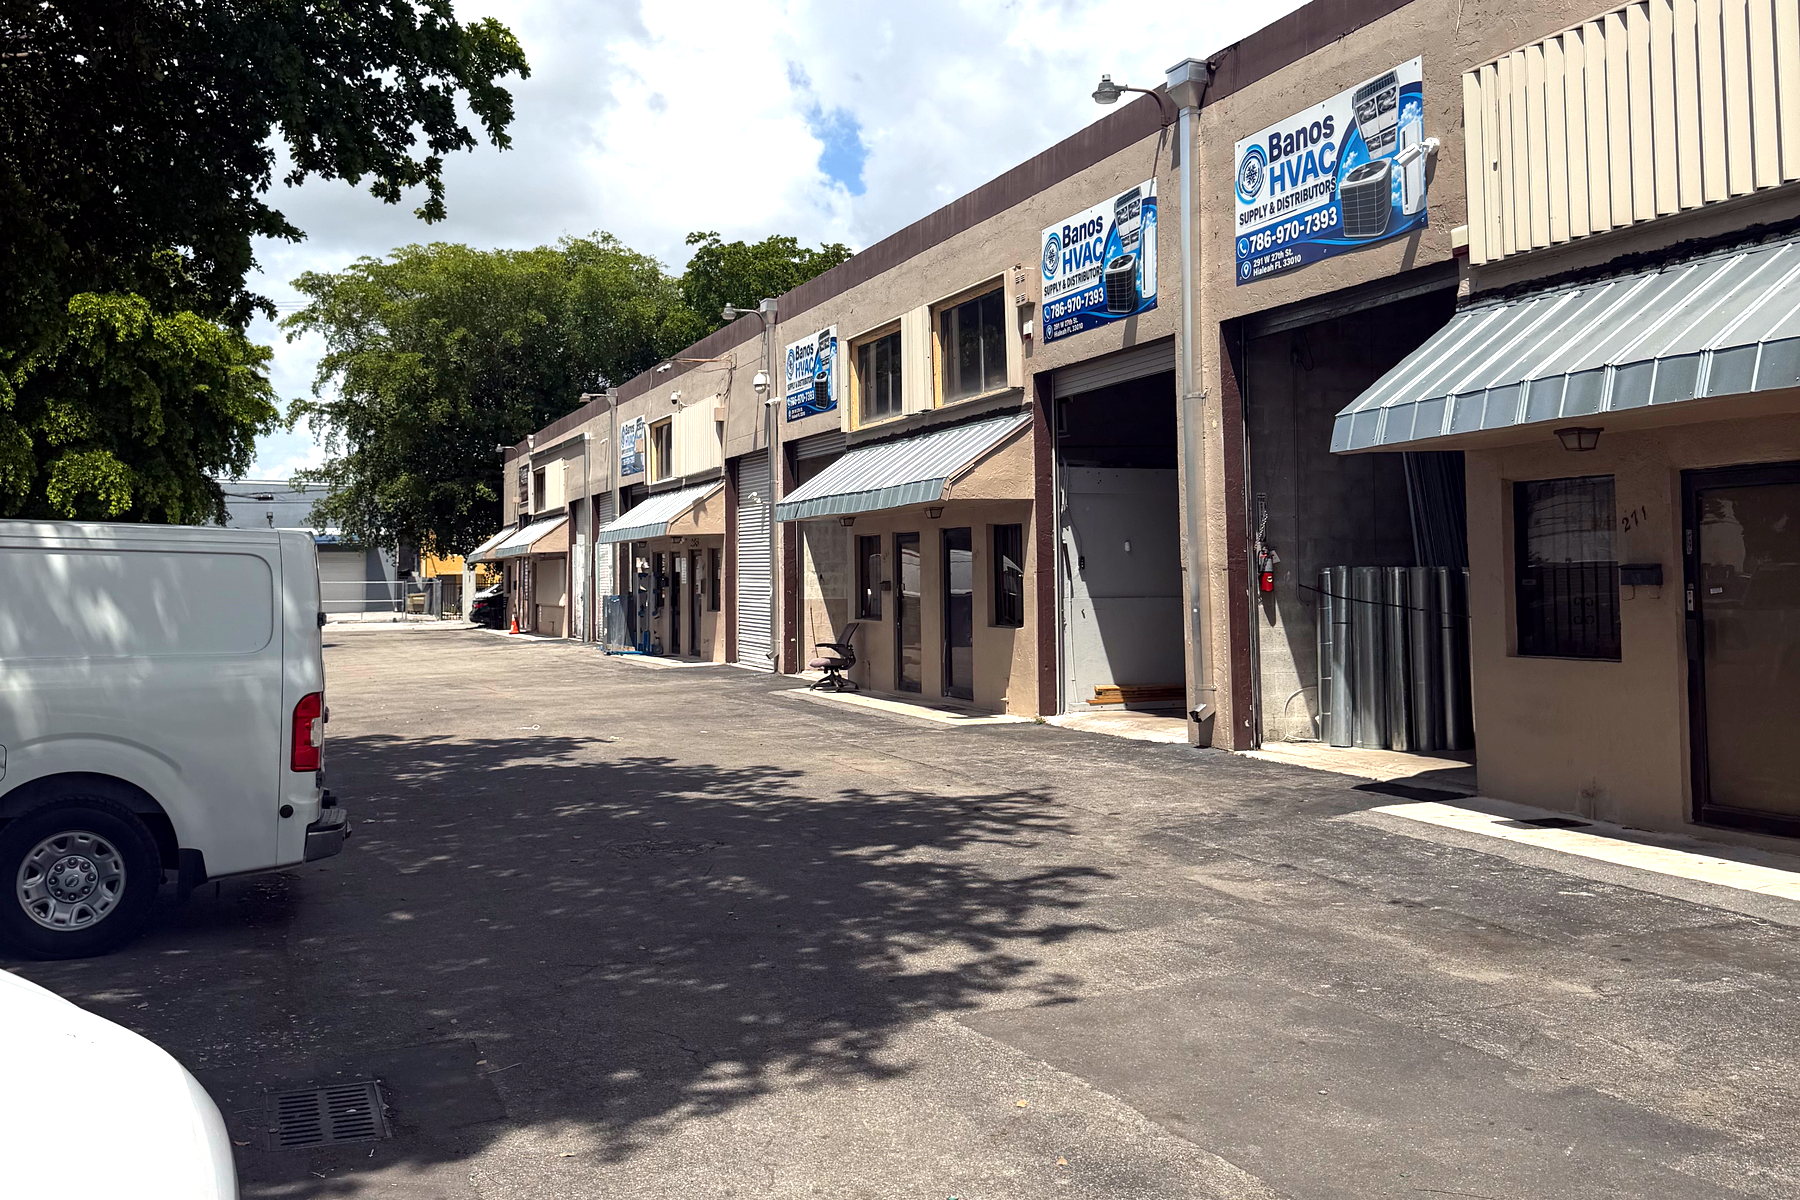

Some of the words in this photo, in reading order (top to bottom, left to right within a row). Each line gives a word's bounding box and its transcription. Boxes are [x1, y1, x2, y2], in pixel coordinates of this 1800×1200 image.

[1268, 114, 1335, 163] Banos
[1269, 142, 1336, 196] HVAC
[1239, 203, 1268, 226] SUPPLY
[1269, 201, 1275, 215] &
[1276, 176, 1337, 213] DISTRIBUTORS
[1062, 215, 1103, 249] Banos
[1249, 206, 1338, 254] 786-970-7393
[1062, 236, 1103, 275] HVAC
[1253, 257, 1263, 268] 291
[1264, 255, 1271, 264] W
[1271, 250, 1284, 262] 27th
[1253, 263, 1274, 277] Hialeah
[1274, 261, 1282, 270] FL
[1282, 254, 1302, 267] 33010
[1044, 280, 1062, 297] SUPPLY
[1062, 279, 1066, 290] &
[1066, 264, 1103, 288] DISTRIBUTORS
[1050, 286, 1104, 319] 786-970-7393
[795, 343, 814, 361] Banos
[795, 356, 814, 379] HVAC
